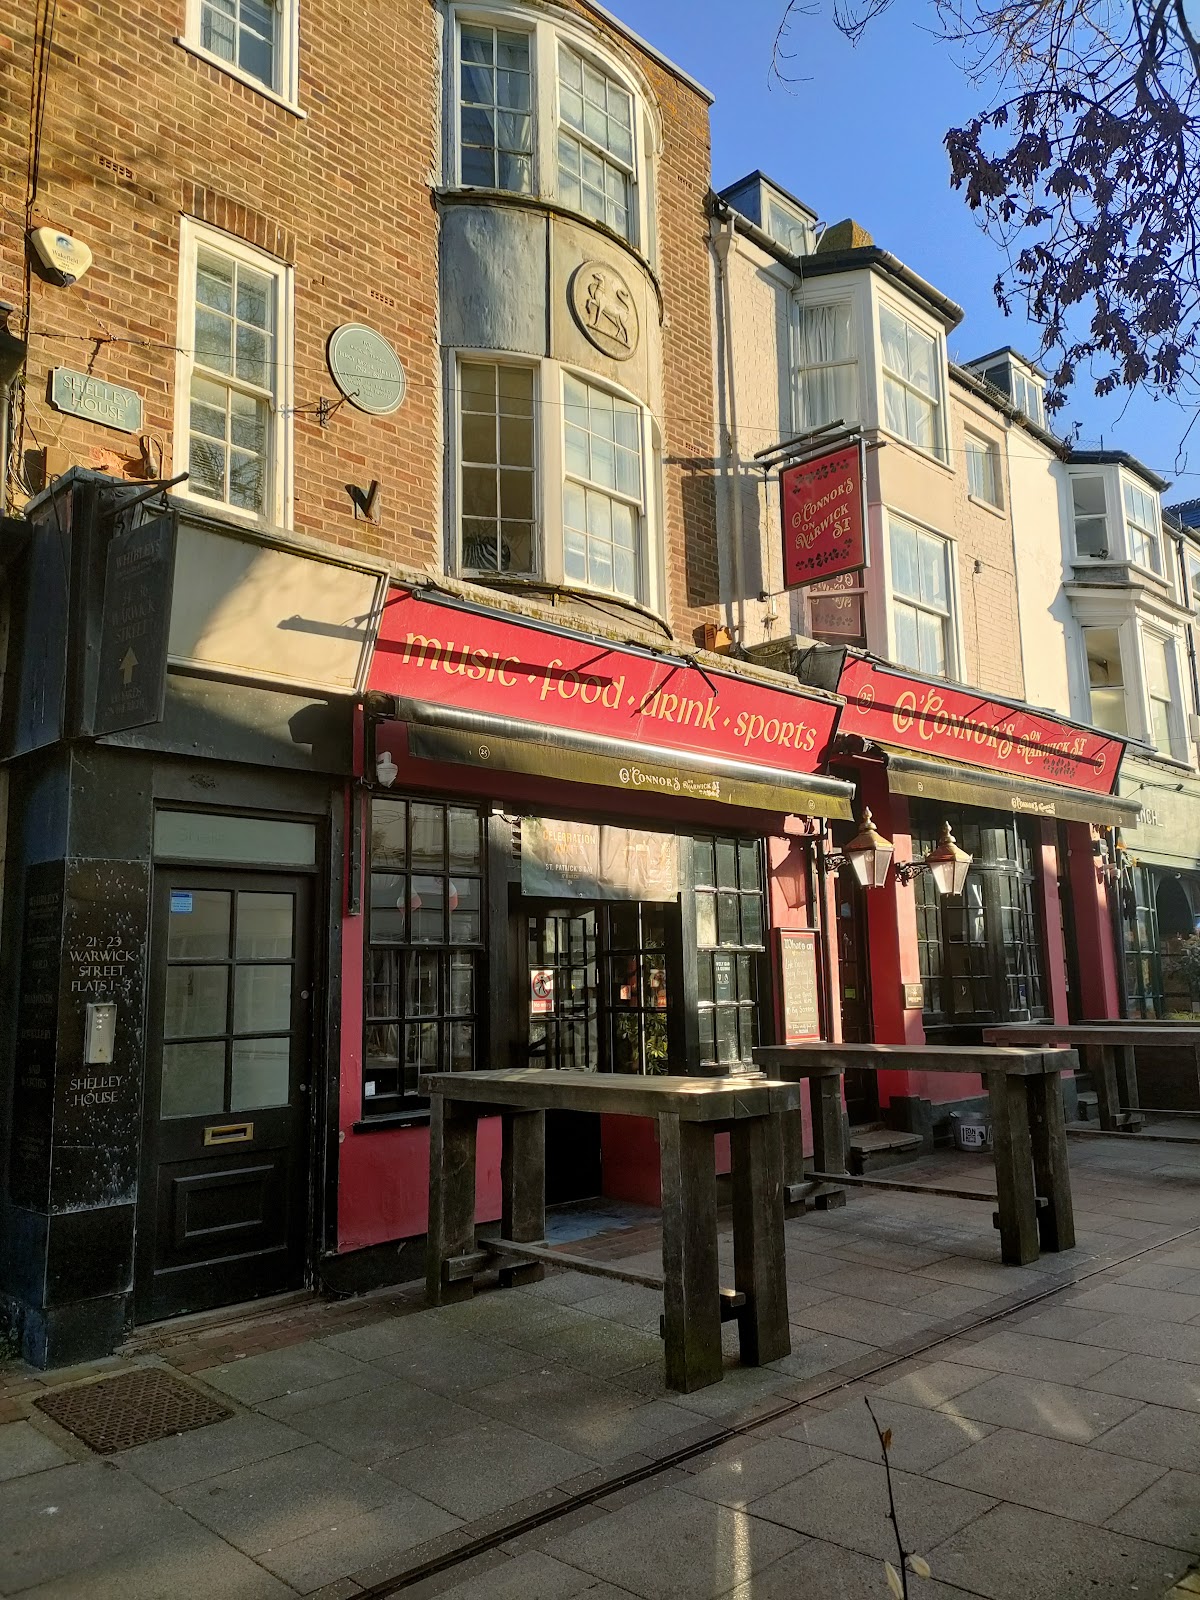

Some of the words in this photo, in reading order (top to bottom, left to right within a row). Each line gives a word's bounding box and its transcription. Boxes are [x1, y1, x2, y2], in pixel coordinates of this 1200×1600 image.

[63, 375, 131, 407] SHELLEY
[71, 391, 126, 423] HOUSE
[791, 477, 854, 529] O'CONNOR'S
[795, 502, 850, 550] WARWICK
[801, 521, 816, 532] ON
[832, 516, 852, 539] ST
[402, 632, 521, 687] music
[539, 658, 626, 709] food
[640, 683, 721, 731] drink
[734, 711, 817, 751] sports
[859, 691, 873, 706] 25
[892, 688, 1017, 760] O'CONNOR'S
[1030, 730, 1042, 742] ON
[1016, 733, 1071, 765] WARWICK
[1069, 737, 1088, 759] ST
[618, 766, 681, 792] O'CONNOR'S
[543, 829, 597, 845] CELEBRATION
[554, 843, 585, 855] AWAITS
[555, 864, 582, 872] PATRICK'S
[70, 950, 135, 962] WARWICK
[79, 965, 126, 977] STREET
[71, 980, 107, 992] FLATS
[69, 1075, 123, 1091] SHELLEY
[74, 1091, 119, 1106] HOUSE
